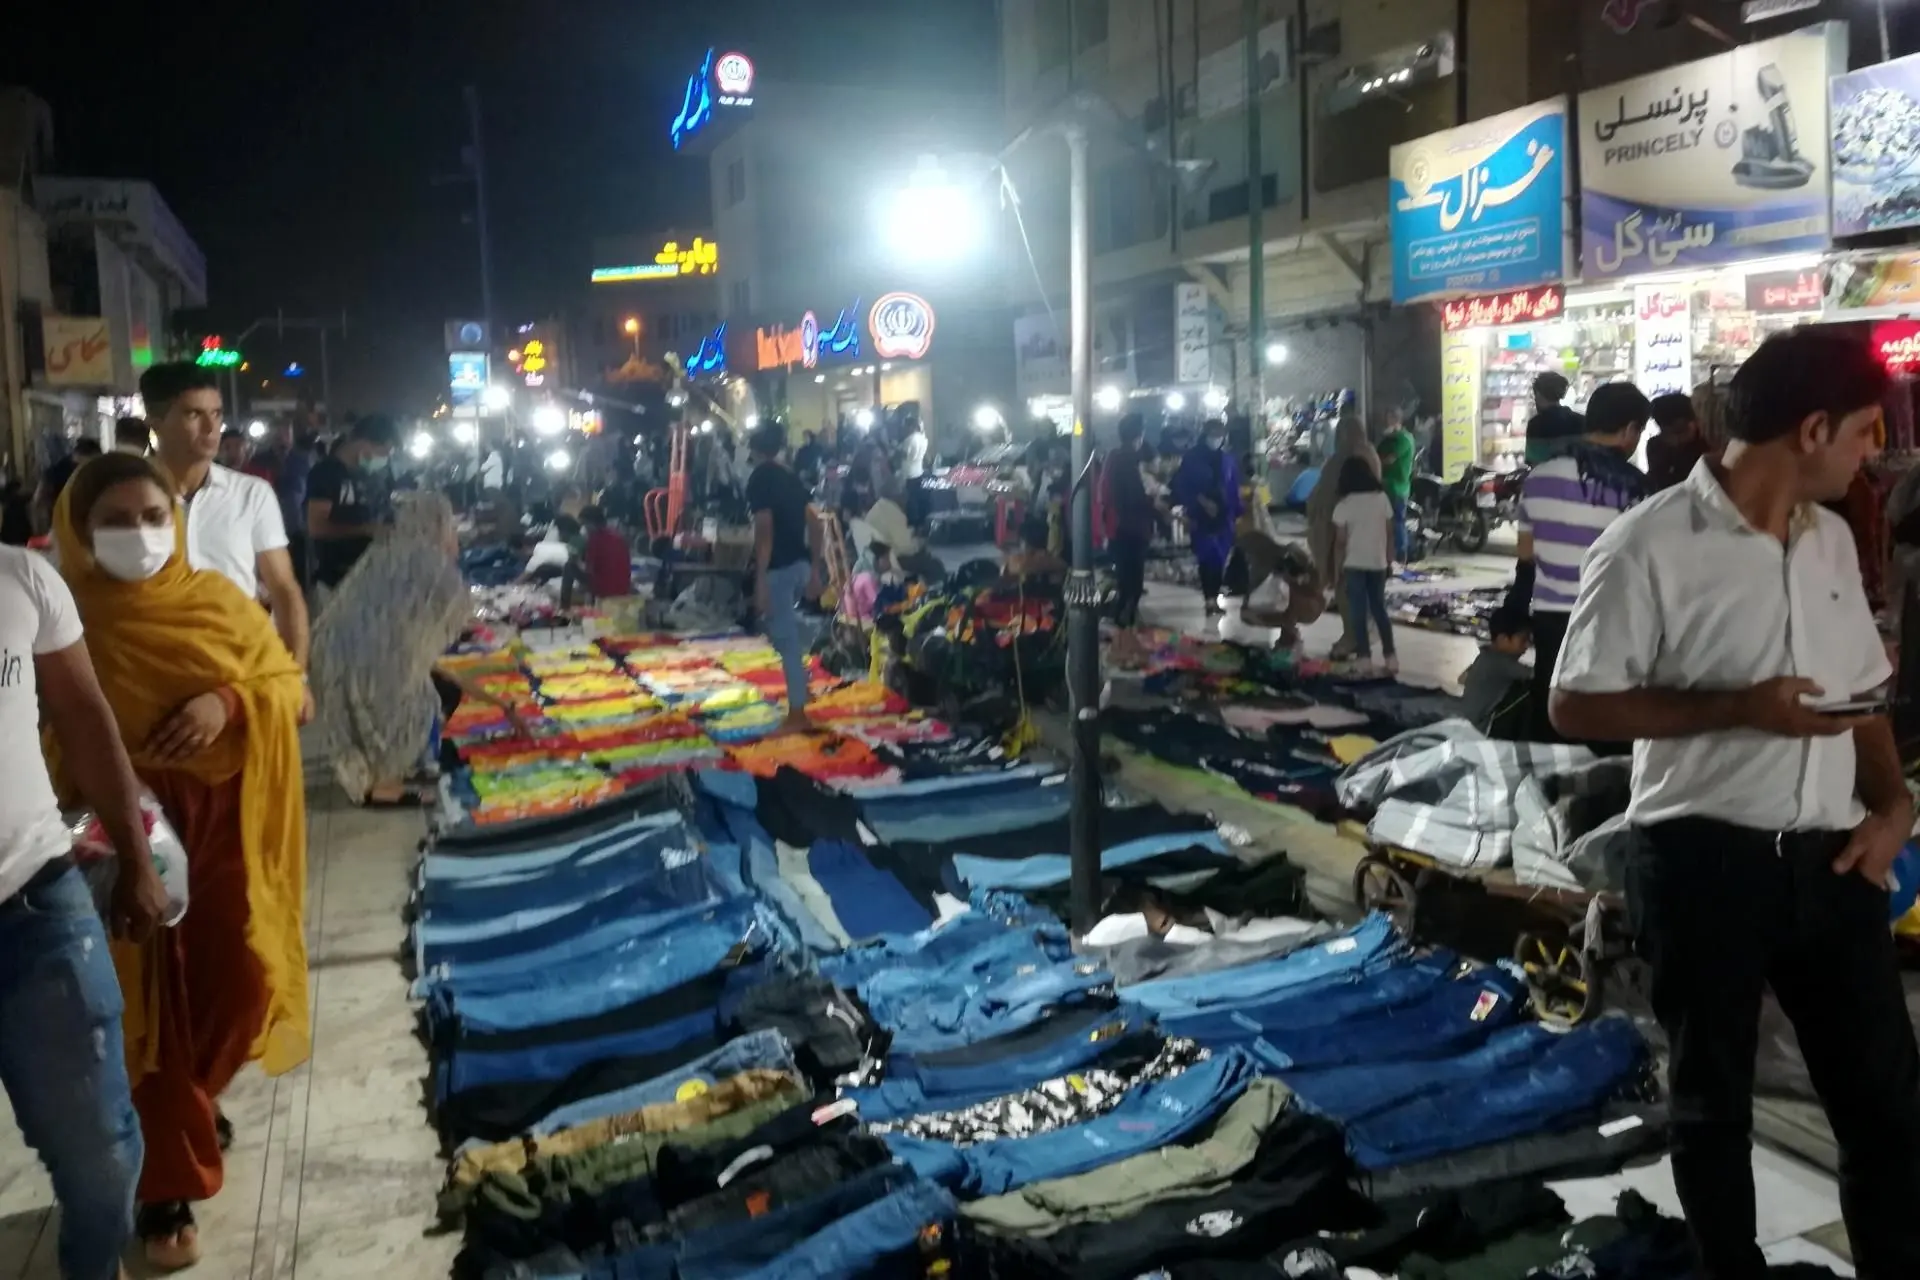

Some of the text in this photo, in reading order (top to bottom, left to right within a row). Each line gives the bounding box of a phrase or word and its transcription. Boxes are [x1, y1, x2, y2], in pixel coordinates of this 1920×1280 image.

[1595, 87, 1709, 141] پرنسلی
[1604, 128, 1704, 166] PRINCELY
[1596, 208, 1644, 273] گل
